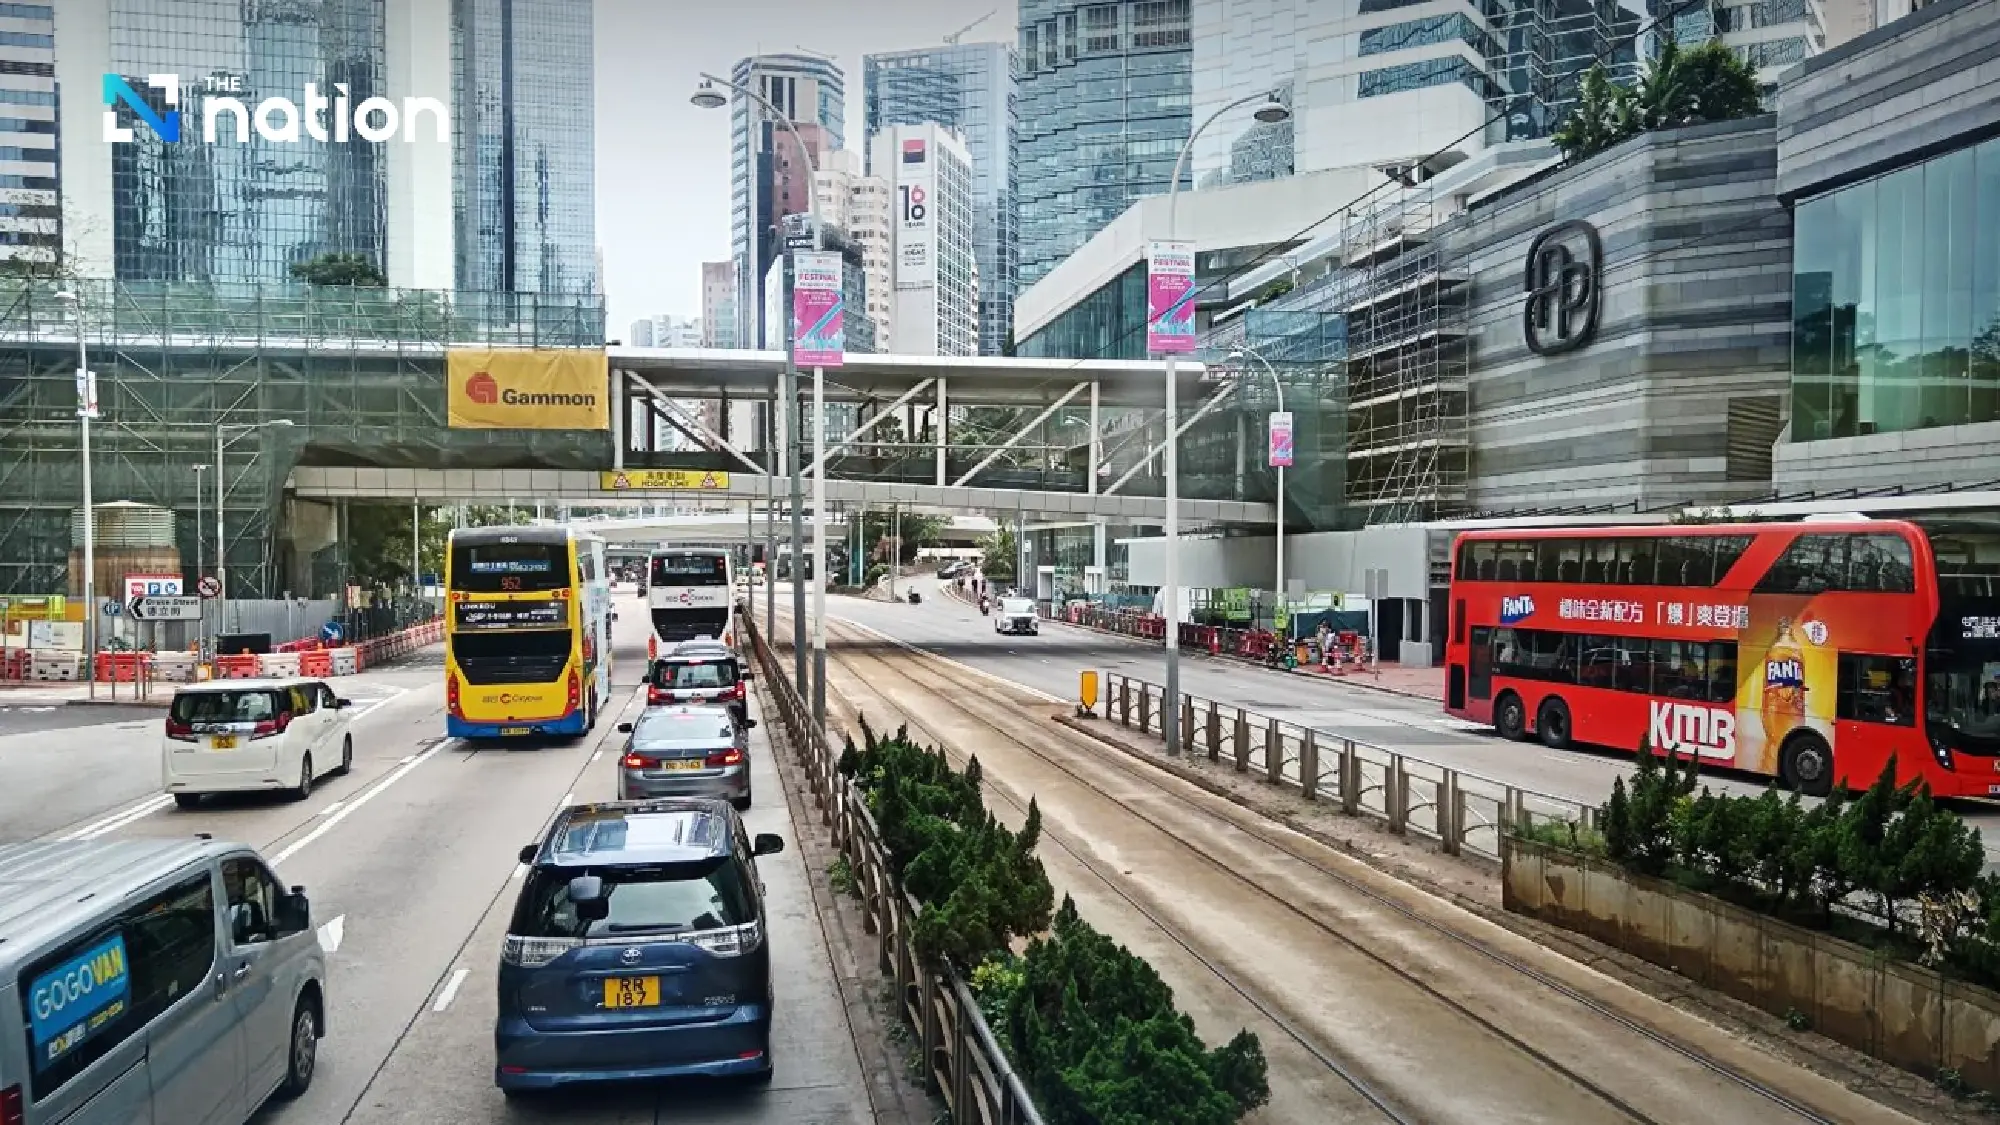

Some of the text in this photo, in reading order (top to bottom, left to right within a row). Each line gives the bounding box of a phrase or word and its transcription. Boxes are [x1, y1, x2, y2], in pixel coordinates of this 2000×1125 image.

[502, 388, 596, 406] Gammon
[501, 576, 521, 589] 952
[1502, 595, 1535, 616] FANTA
[1650, 699, 1735, 759] KMB
[35, 945, 124, 1019] GOGOVAN
[619, 978, 645, 992] RR
[616, 992, 647, 1006] 187
